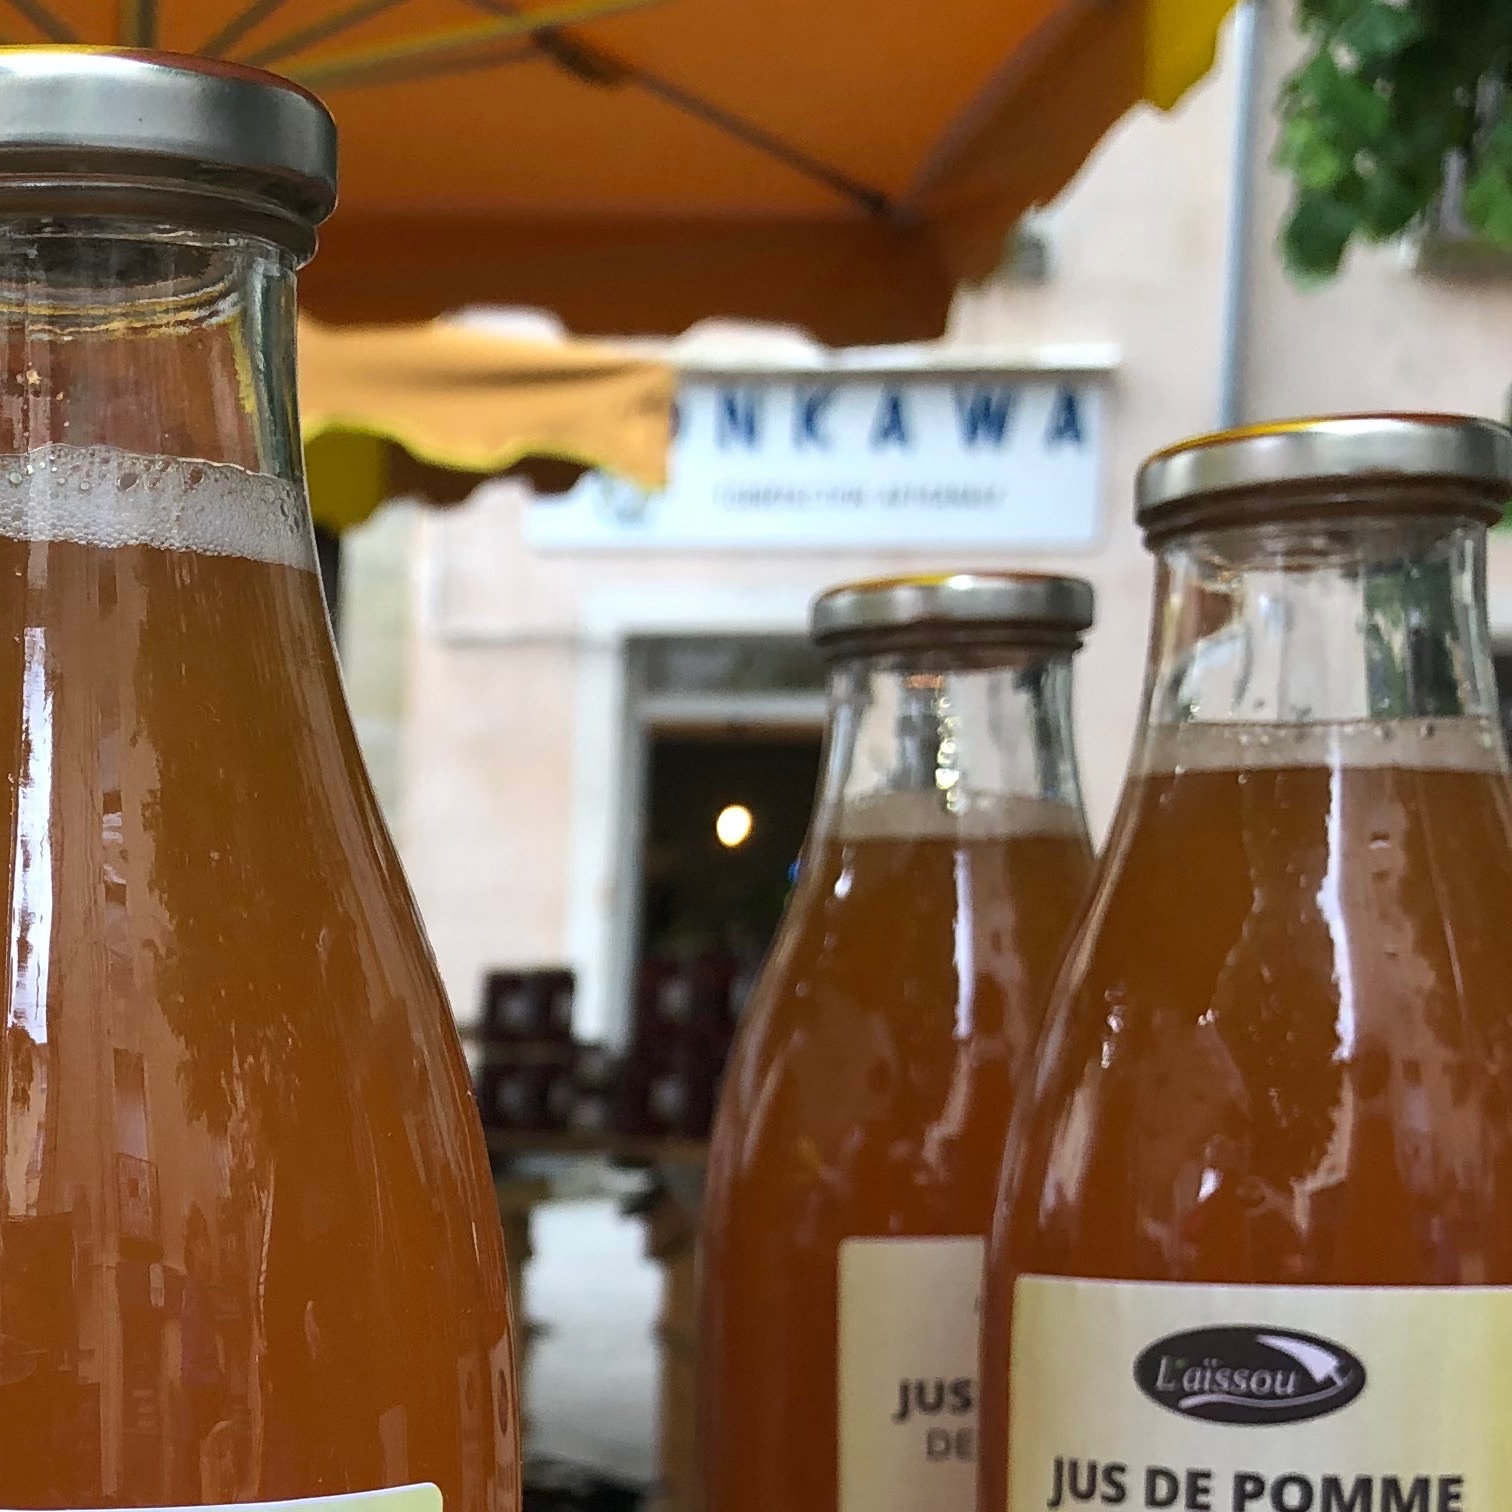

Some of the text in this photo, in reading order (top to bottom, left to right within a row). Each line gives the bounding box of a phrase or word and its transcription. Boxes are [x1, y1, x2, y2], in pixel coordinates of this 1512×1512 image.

[669, 380, 1086, 452] NKAWA
[892, 1377, 972, 1425] JUS
[1048, 1456, 1127, 1511] JUS
[1145, 1466, 1213, 1512] DE
